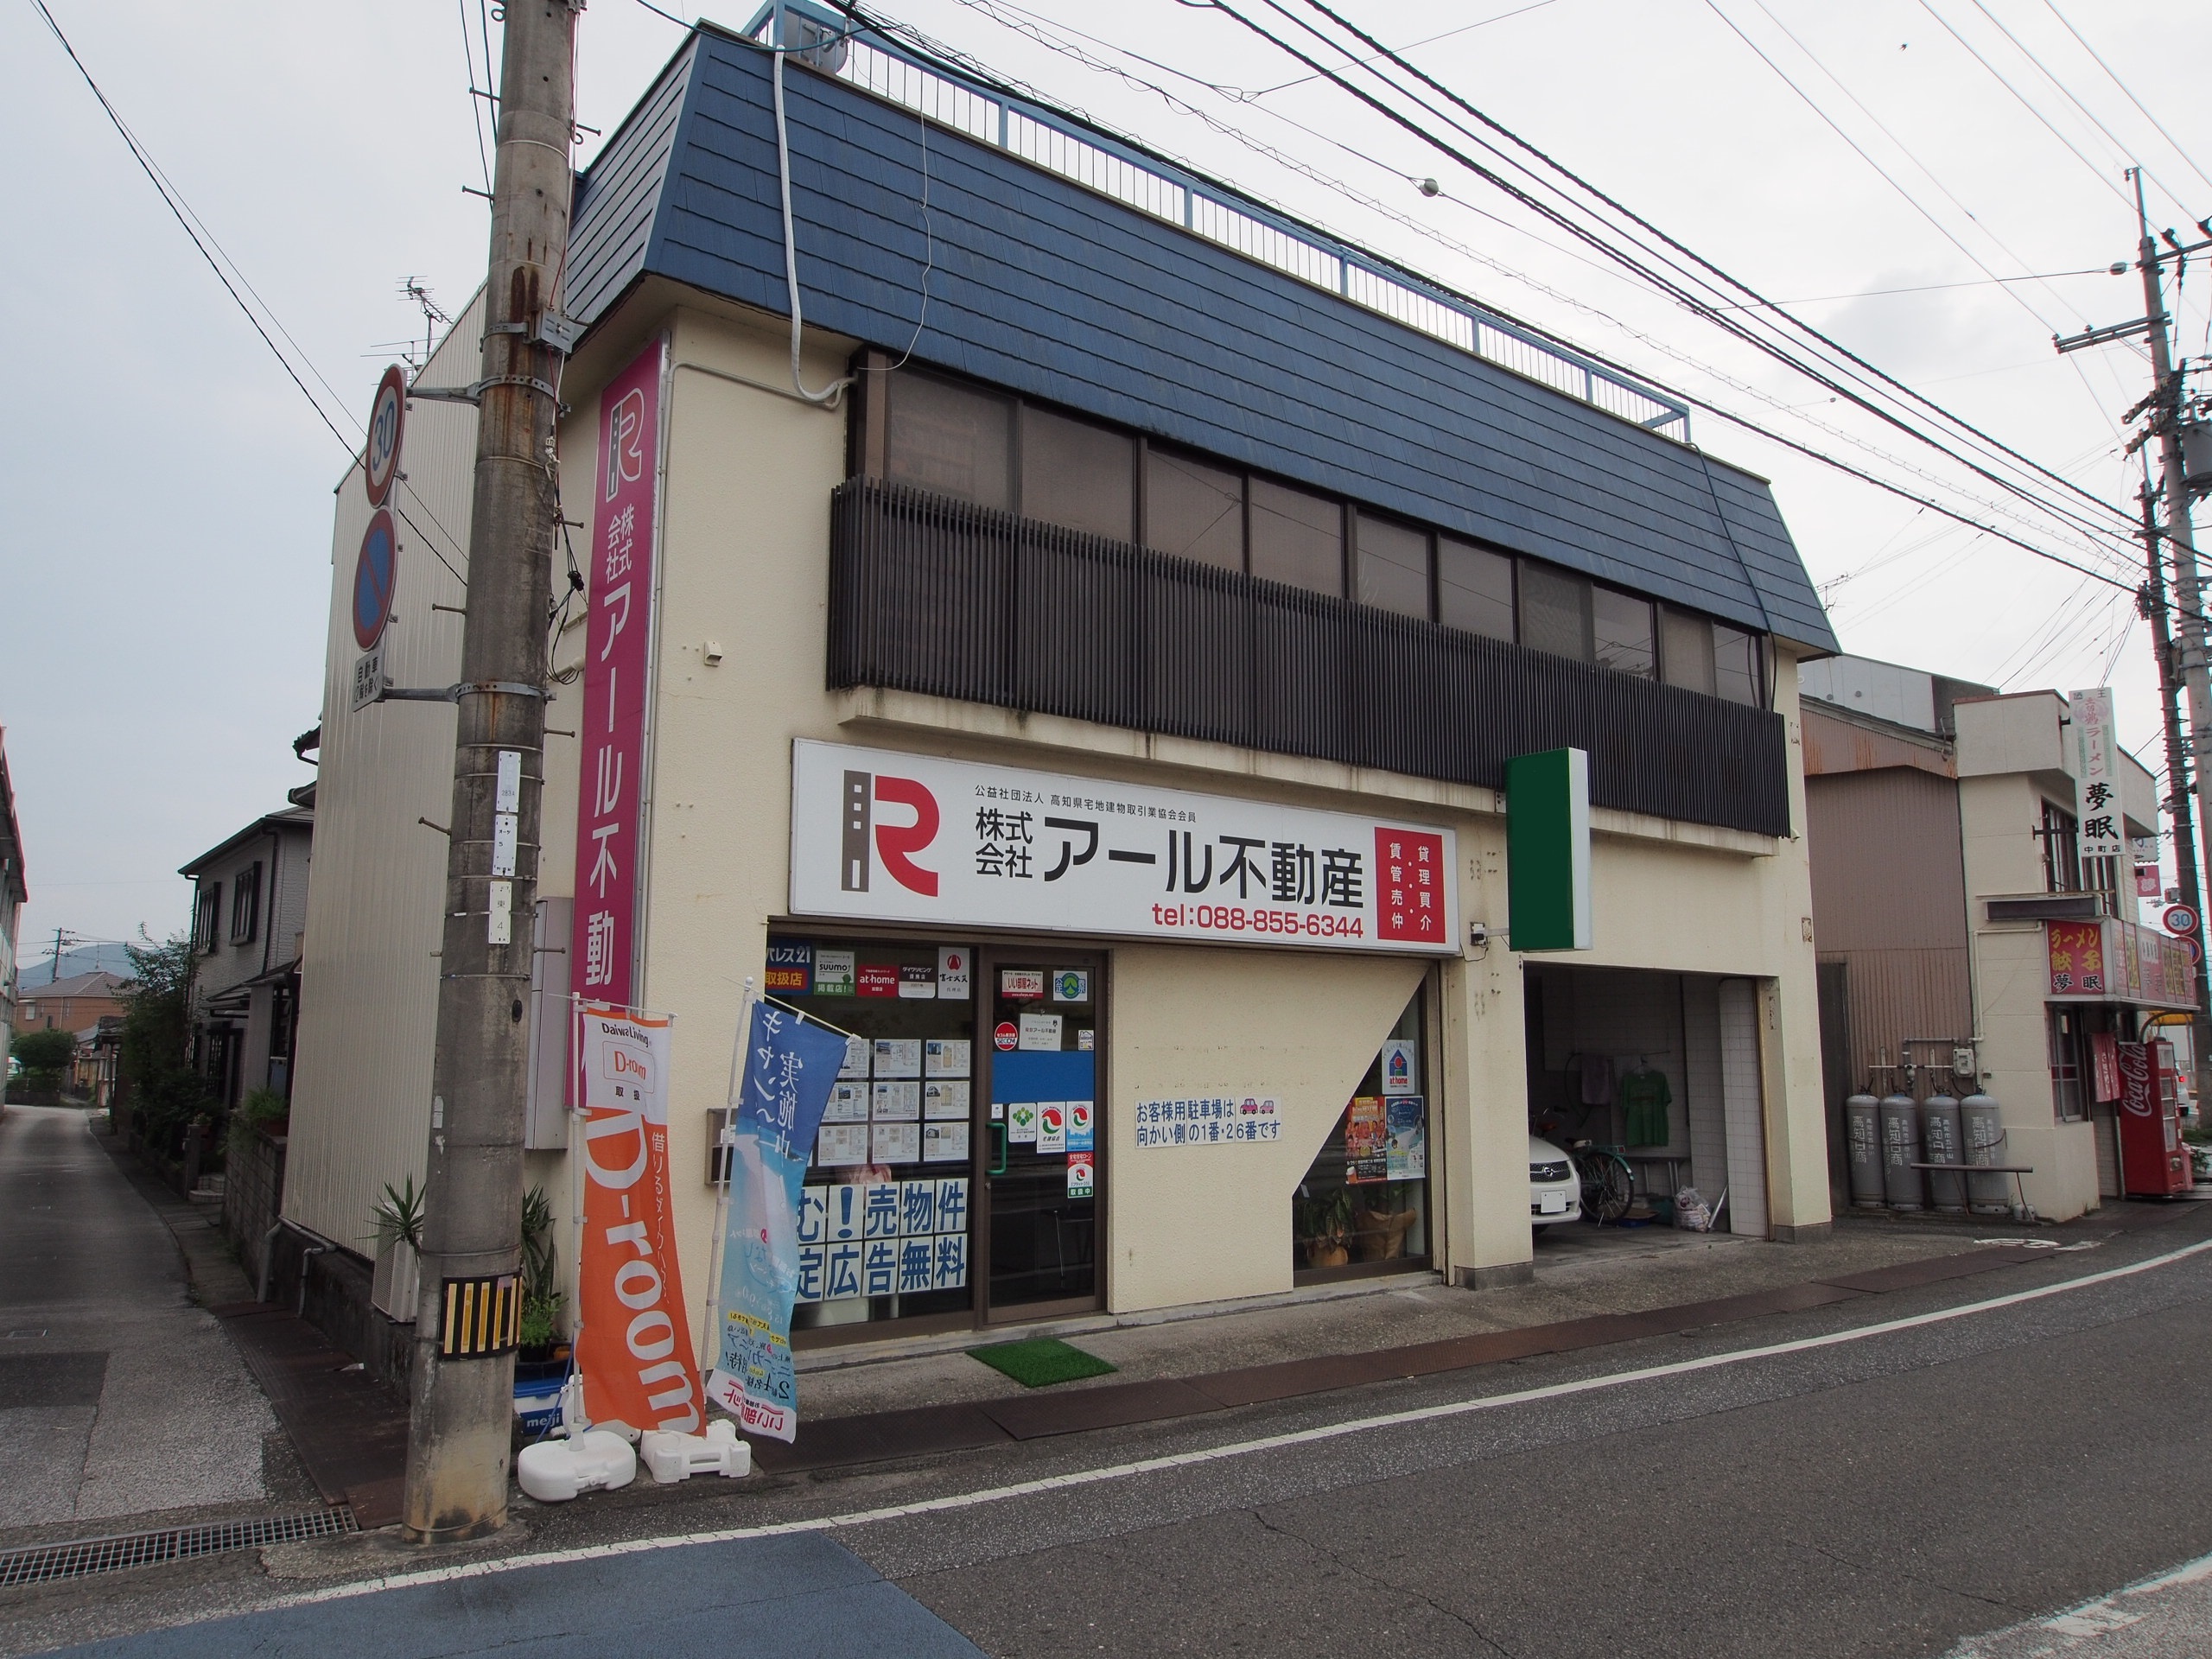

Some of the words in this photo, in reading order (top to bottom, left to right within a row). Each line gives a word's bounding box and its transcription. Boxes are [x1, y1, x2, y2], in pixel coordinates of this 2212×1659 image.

[372, 401, 394, 472] 30
[2085, 727, 2103, 776] ラーメン
[976, 785, 1044, 804] 公益社団法人
[1051, 794, 1196, 823] 高知県宅地建物取引業協会会員
[2084, 782, 2119, 839] 夢眠
[976, 806, 1033, 844] 株式
[976, 842, 1033, 879] 会社
[1045, 817, 1363, 908] アール不動産
[2051, 927, 2098, 949] ラーメン
[2171, 913, 2190, 927] 30
[766, 971, 803, 986] 取扱店
[2050, 950, 2101, 971] 餃子
[2053, 973, 2102, 993] 夢眠
[1136, 1099, 1234, 1123] お客様用駐車場は
[1888, 1116, 1903, 1166] 高知日商
[1929, 1116, 1945, 1164] 高知日商
[586, 1113, 700, 1433] D-room
